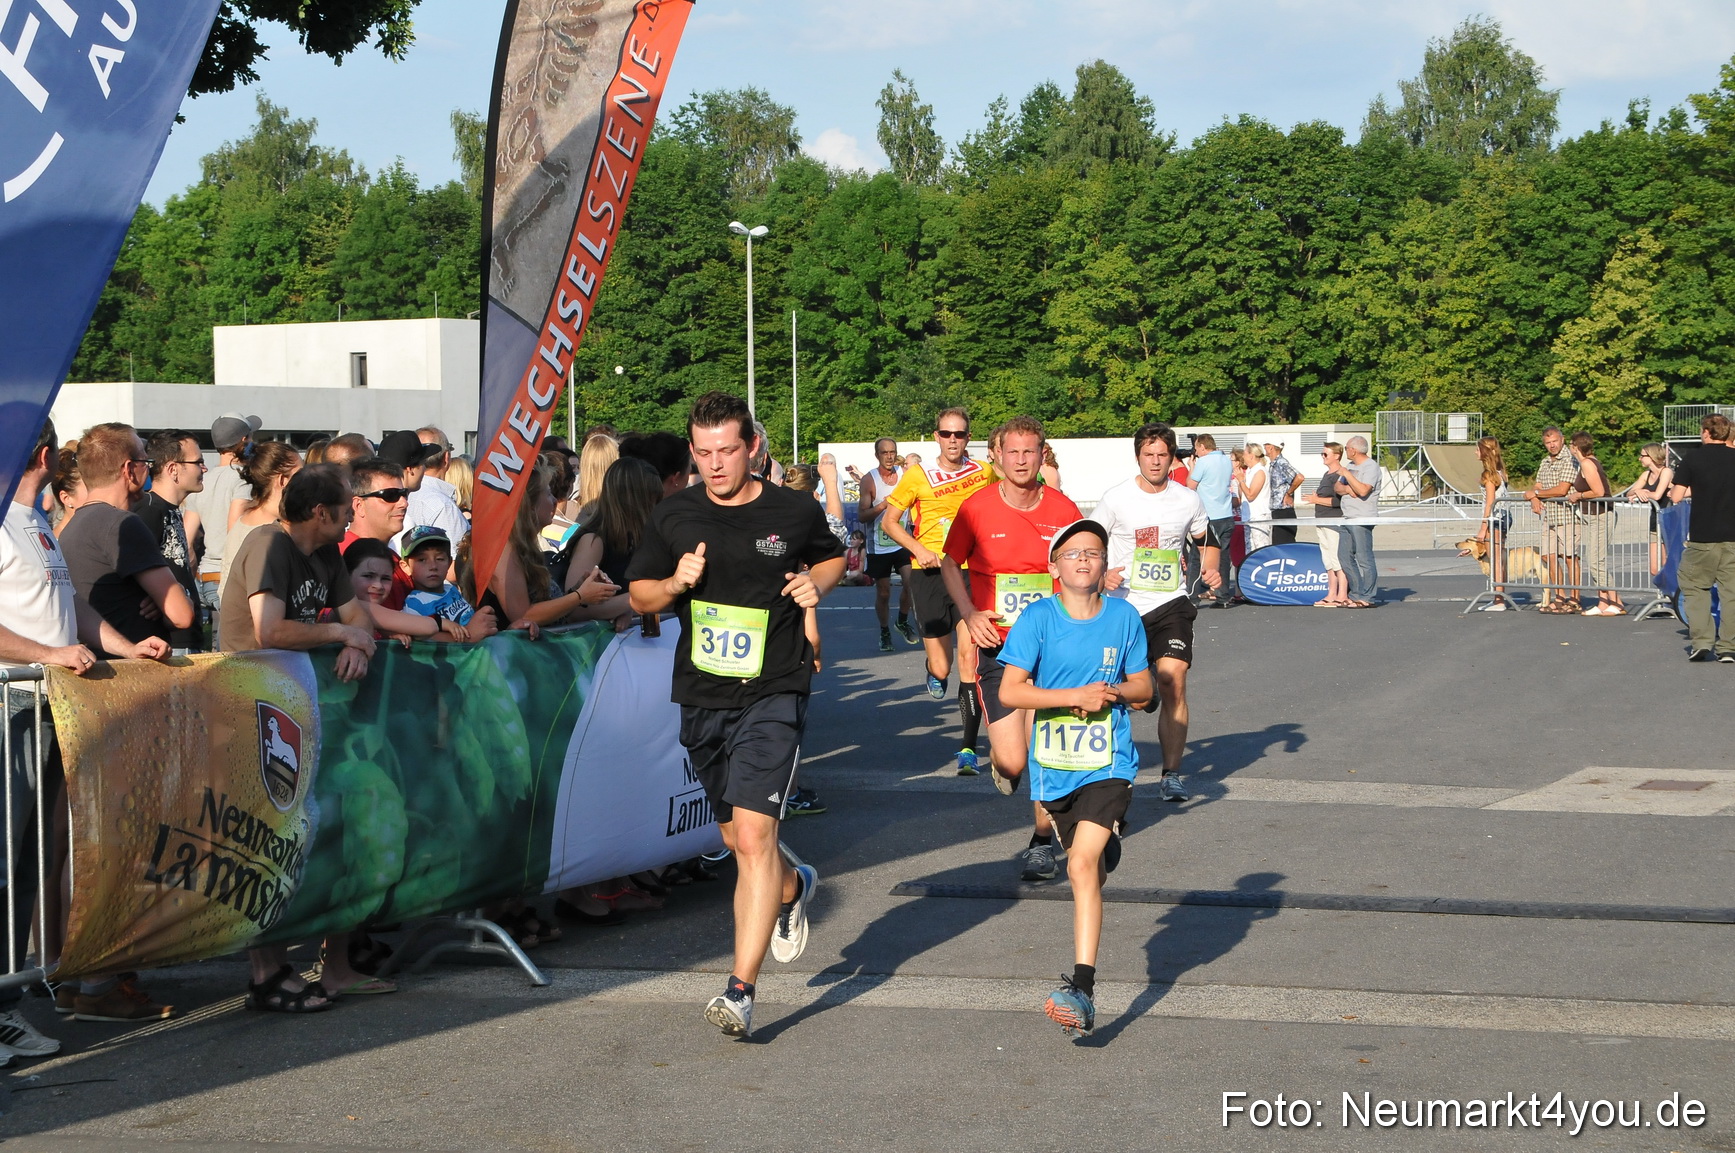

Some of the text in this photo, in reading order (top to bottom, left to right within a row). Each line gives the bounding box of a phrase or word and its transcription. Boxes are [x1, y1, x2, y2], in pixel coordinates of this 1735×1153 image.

[478, 0, 662, 495] WECHSELSZENE.D
[933, 474, 988, 498] MAX BÖGL
[1138, 563, 1172, 582] 565
[1273, 584, 1330, 592] AUTOMOBIL
[701, 627, 752, 659] 319
[1039, 721, 1108, 753] 1178
[272, 778, 289, 803] 1628
